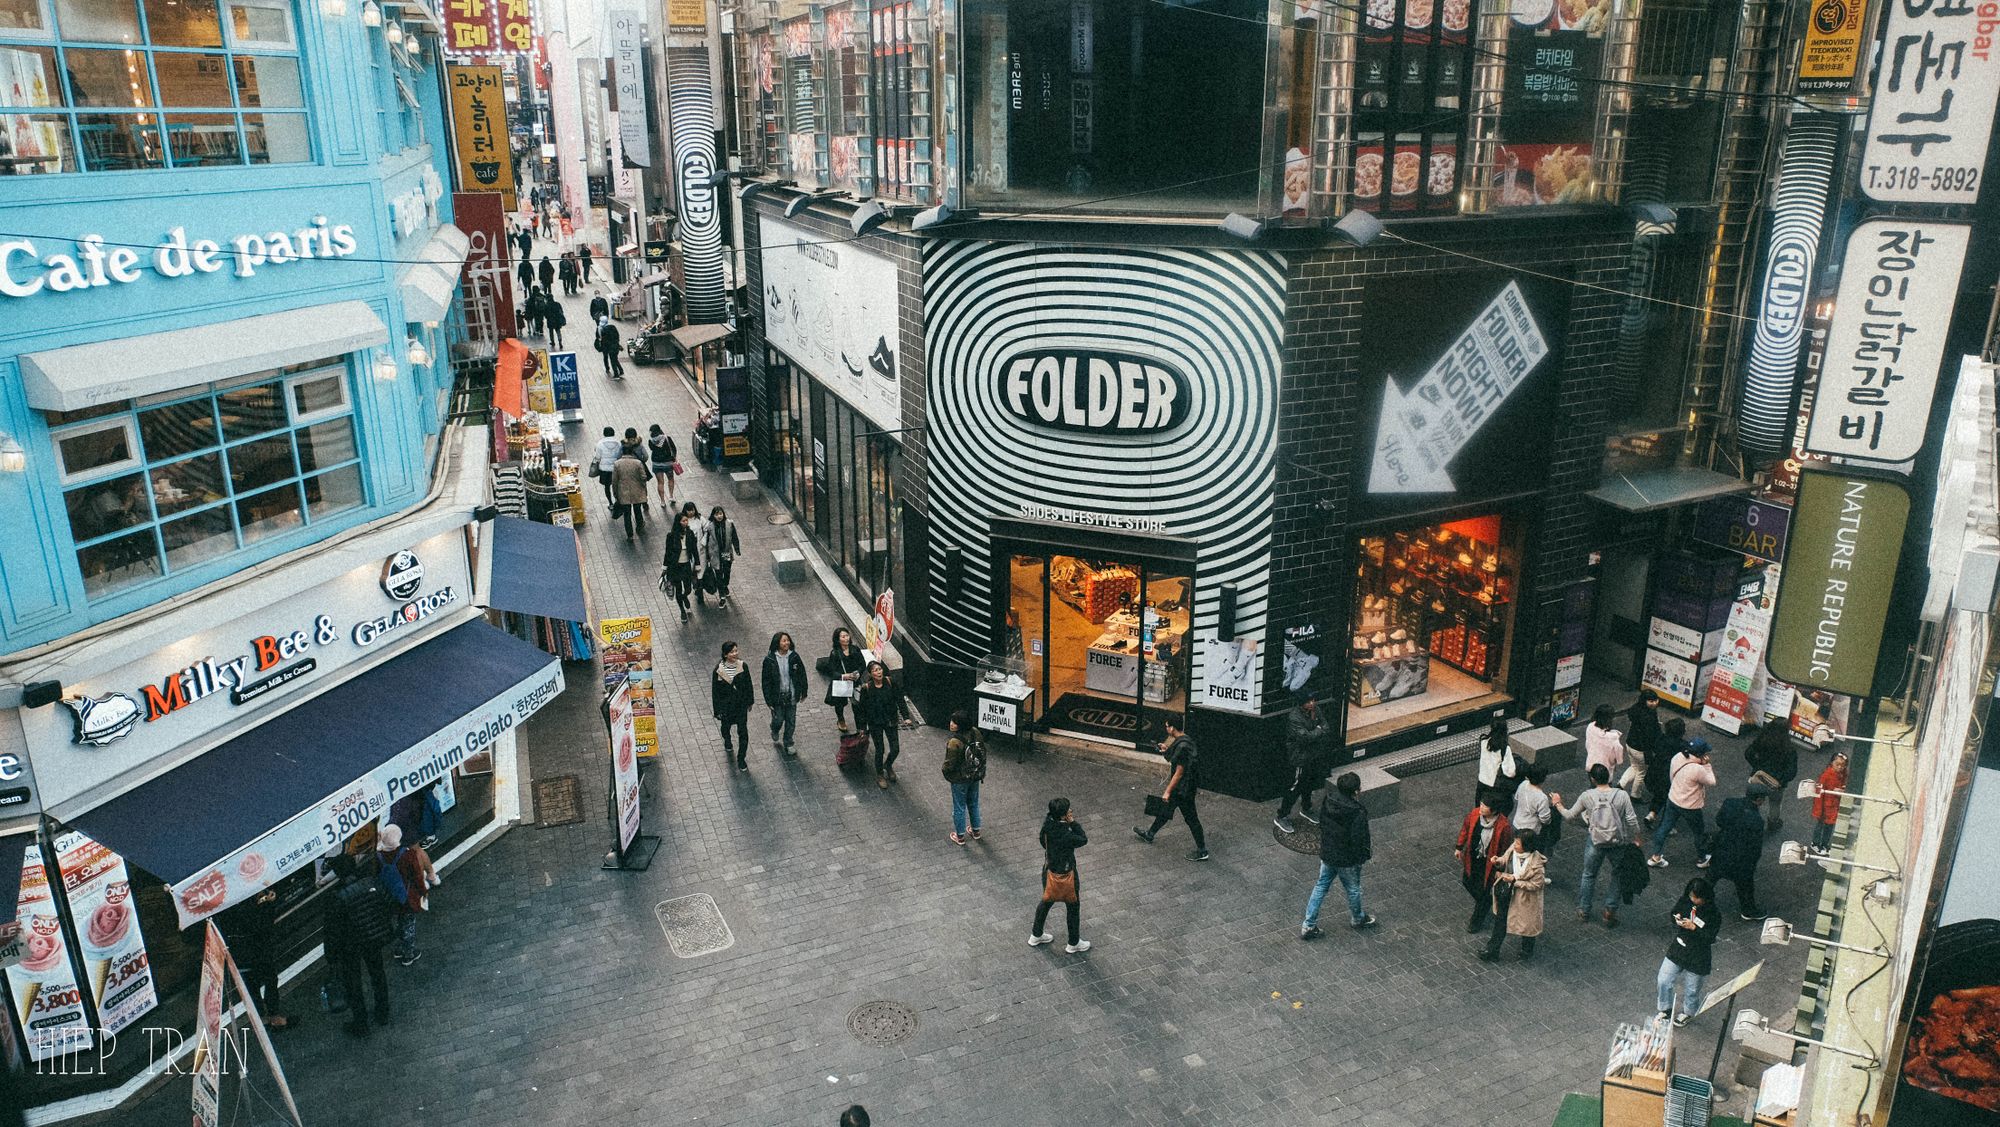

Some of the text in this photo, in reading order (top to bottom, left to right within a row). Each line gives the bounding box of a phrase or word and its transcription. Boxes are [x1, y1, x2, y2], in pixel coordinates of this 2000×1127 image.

[1811, 38, 1854, 46] IMPROVISED
[1535, 48, 1574, 68] 런치타임
[456, 73, 498, 93] 고양이
[475, 166, 498, 178] cafe
[1868, 165, 1978, 192] T.318-5892
[683, 155, 708, 225] FOLDER
[0, 214, 358, 298] Cafe de paris
[1766, 247, 1805, 334] FOLDER
[1482, 304, 1528, 381] FOLDER
[1839, 230, 1935, 450] 장인닭갈비
[553, 371, 577, 382] MART
[556, 356, 572, 372] K
[1455, 333, 1503, 406] RIGHT
[1006, 356, 1178, 428] FOLDER
[1436, 354, 1484, 430] NOW!
[1020, 504, 1167, 533] SHOES LIFESTYLE STORE
[1747, 505, 1760, 527] 6
[1728, 522, 1777, 558] BAR
[1809, 482, 1868, 681] NATURE REPUBLIC
[602, 619, 650, 636] Everything
[1291, 624, 1315, 638] FILA
[138, 586, 458, 722] Milky Bee & GELA ROSA
[1089, 652, 1123, 668] FORCE
[240, 684, 268, 702] Premium
[268, 675, 283, 688] Milk
[293, 663, 313, 676] Cream
[1209, 684, 1249, 702] FORCE
[982, 713, 1012, 728] ARRIVAL
[988, 703, 1006, 715] NEW
[387, 745, 463, 799] Premium
[465, 713, 513, 751] Gelato
[105, 884, 129, 897] ONLY
[187, 879, 224, 909] SALE
[31, 919, 60, 929] ONLY
[107, 953, 149, 990] 3,800
[112, 952, 131, 970] 5,500
[34, 989, 81, 1013] 3,800
